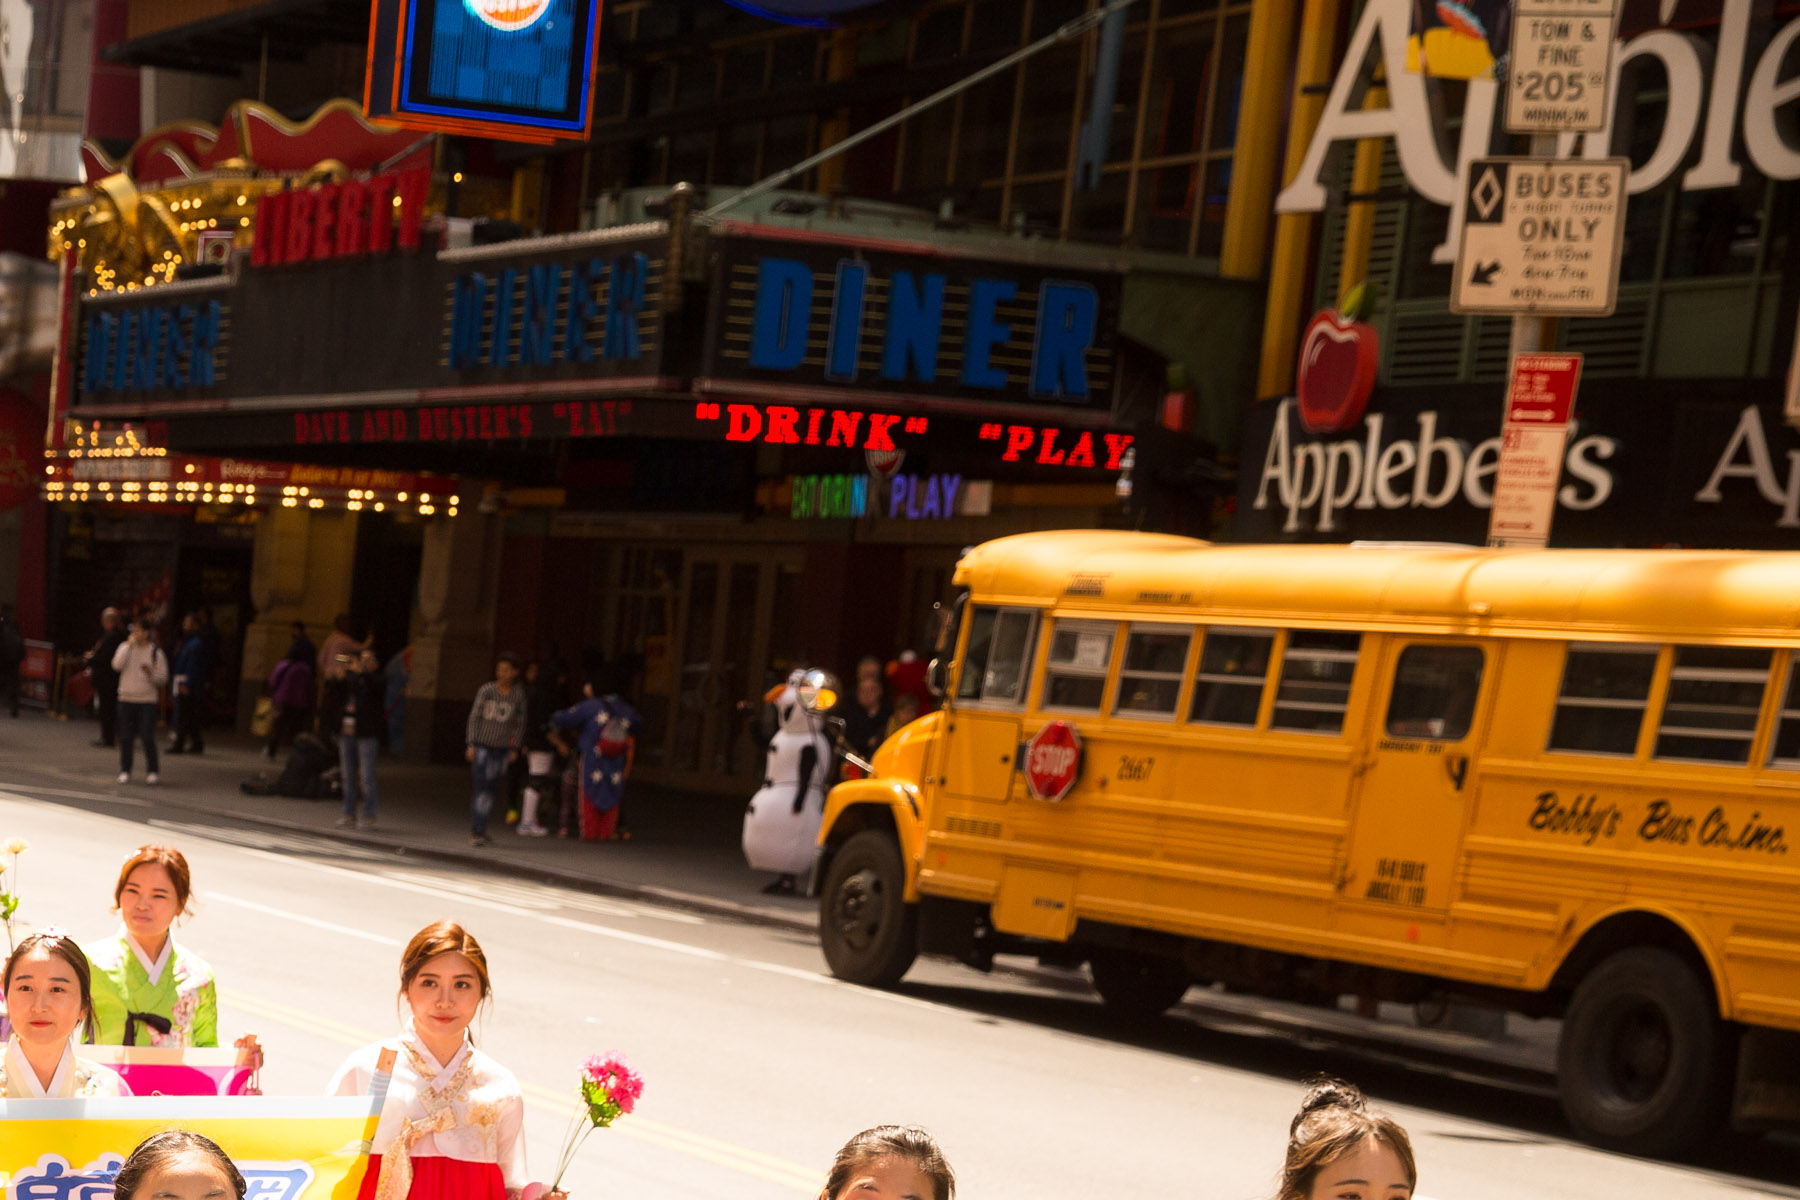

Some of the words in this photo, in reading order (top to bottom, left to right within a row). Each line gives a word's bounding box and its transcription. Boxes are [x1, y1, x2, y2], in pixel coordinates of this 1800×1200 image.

[1538, 44, 1583, 66] FINE
[1517, 172, 1613, 199] BUSES
[1518, 216, 1600, 241] ONLY
[450, 250, 654, 370] DINER
[750, 256, 1100, 402] DINER
[294, 412, 350, 444] DAVE
[361, 409, 407, 442] AND
[696, 402, 929, 451] "DRINK"
[1254, 396, 1617, 533] Applebe's
[889, 473, 962, 521] PLAY
[1032, 744, 1075, 776] STOP
[1528, 791, 1622, 846] Bobby's
[1638, 800, 1695, 846] Bus
